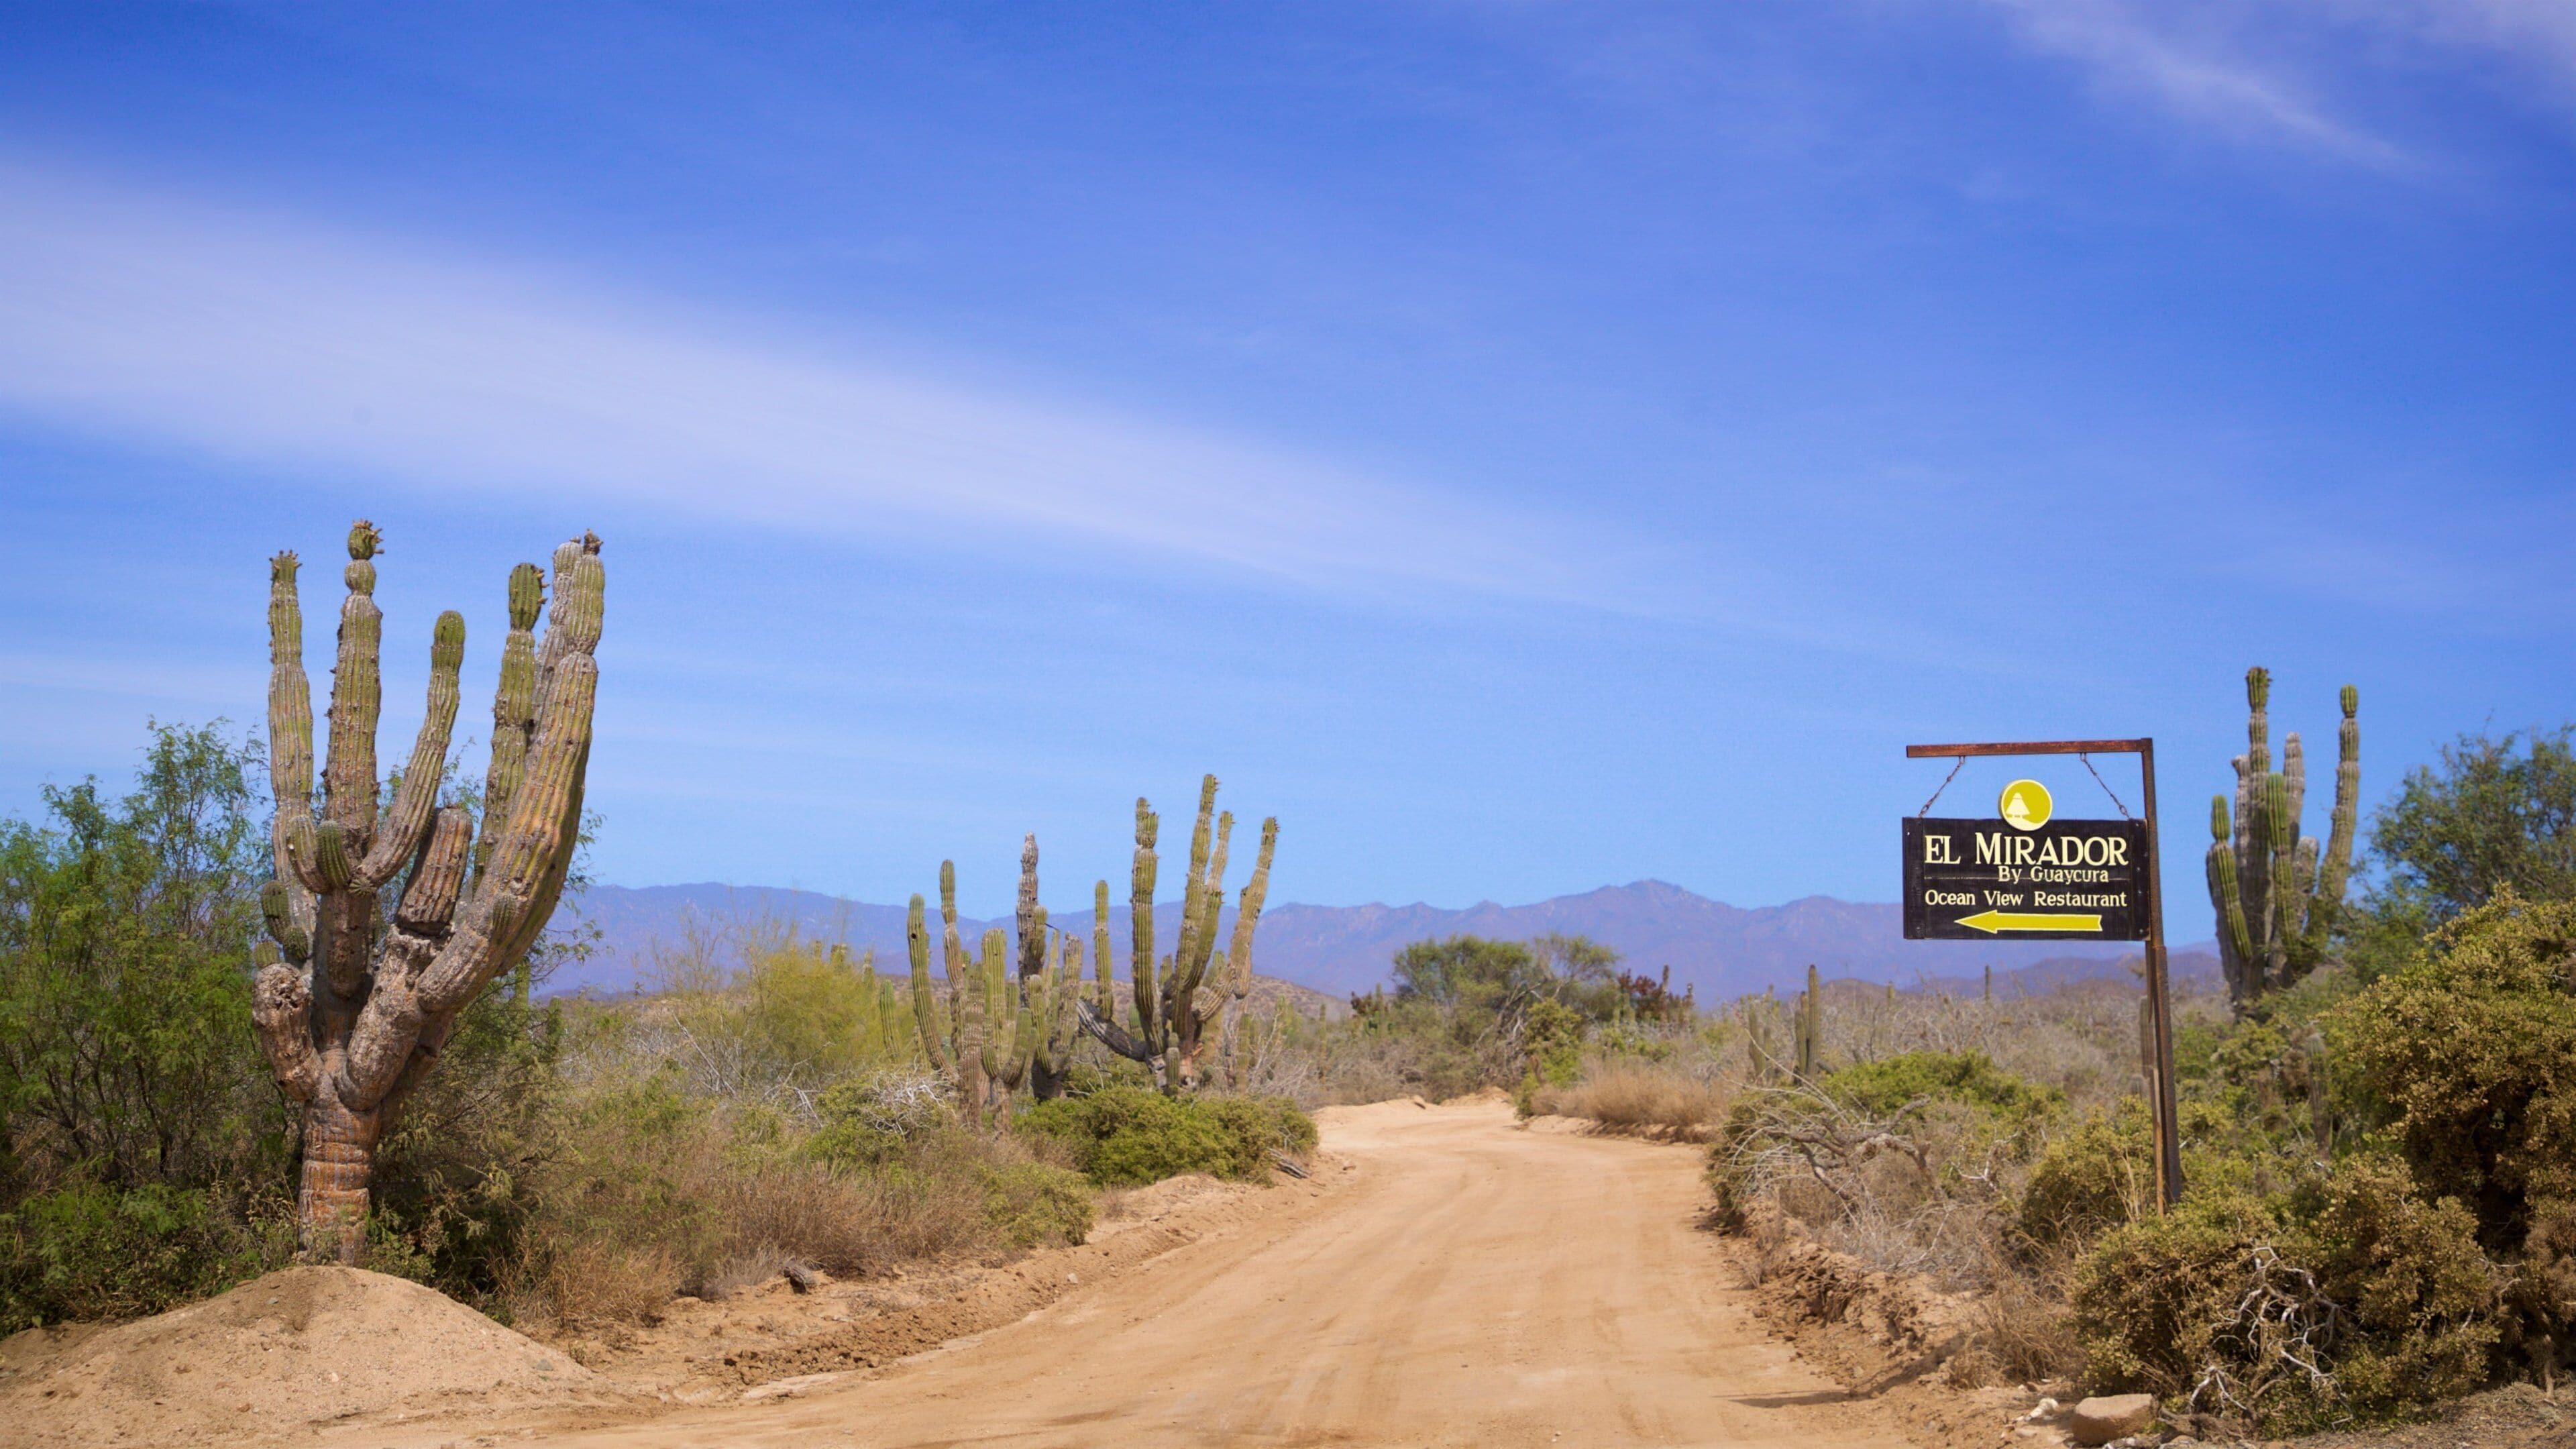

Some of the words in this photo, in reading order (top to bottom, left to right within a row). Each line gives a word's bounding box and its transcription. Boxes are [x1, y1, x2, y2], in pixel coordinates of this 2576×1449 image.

[1924, 835, 1961, 865] EL
[1975, 832, 2129, 866] MIRADOR
[1998, 865, 2021, 884] By
[2030, 866, 2109, 885] Guaycura
[1925, 890, 1976, 906] Ocean
[1984, 890, 2024, 906] View
[2034, 891, 2127, 907] Restaurant
